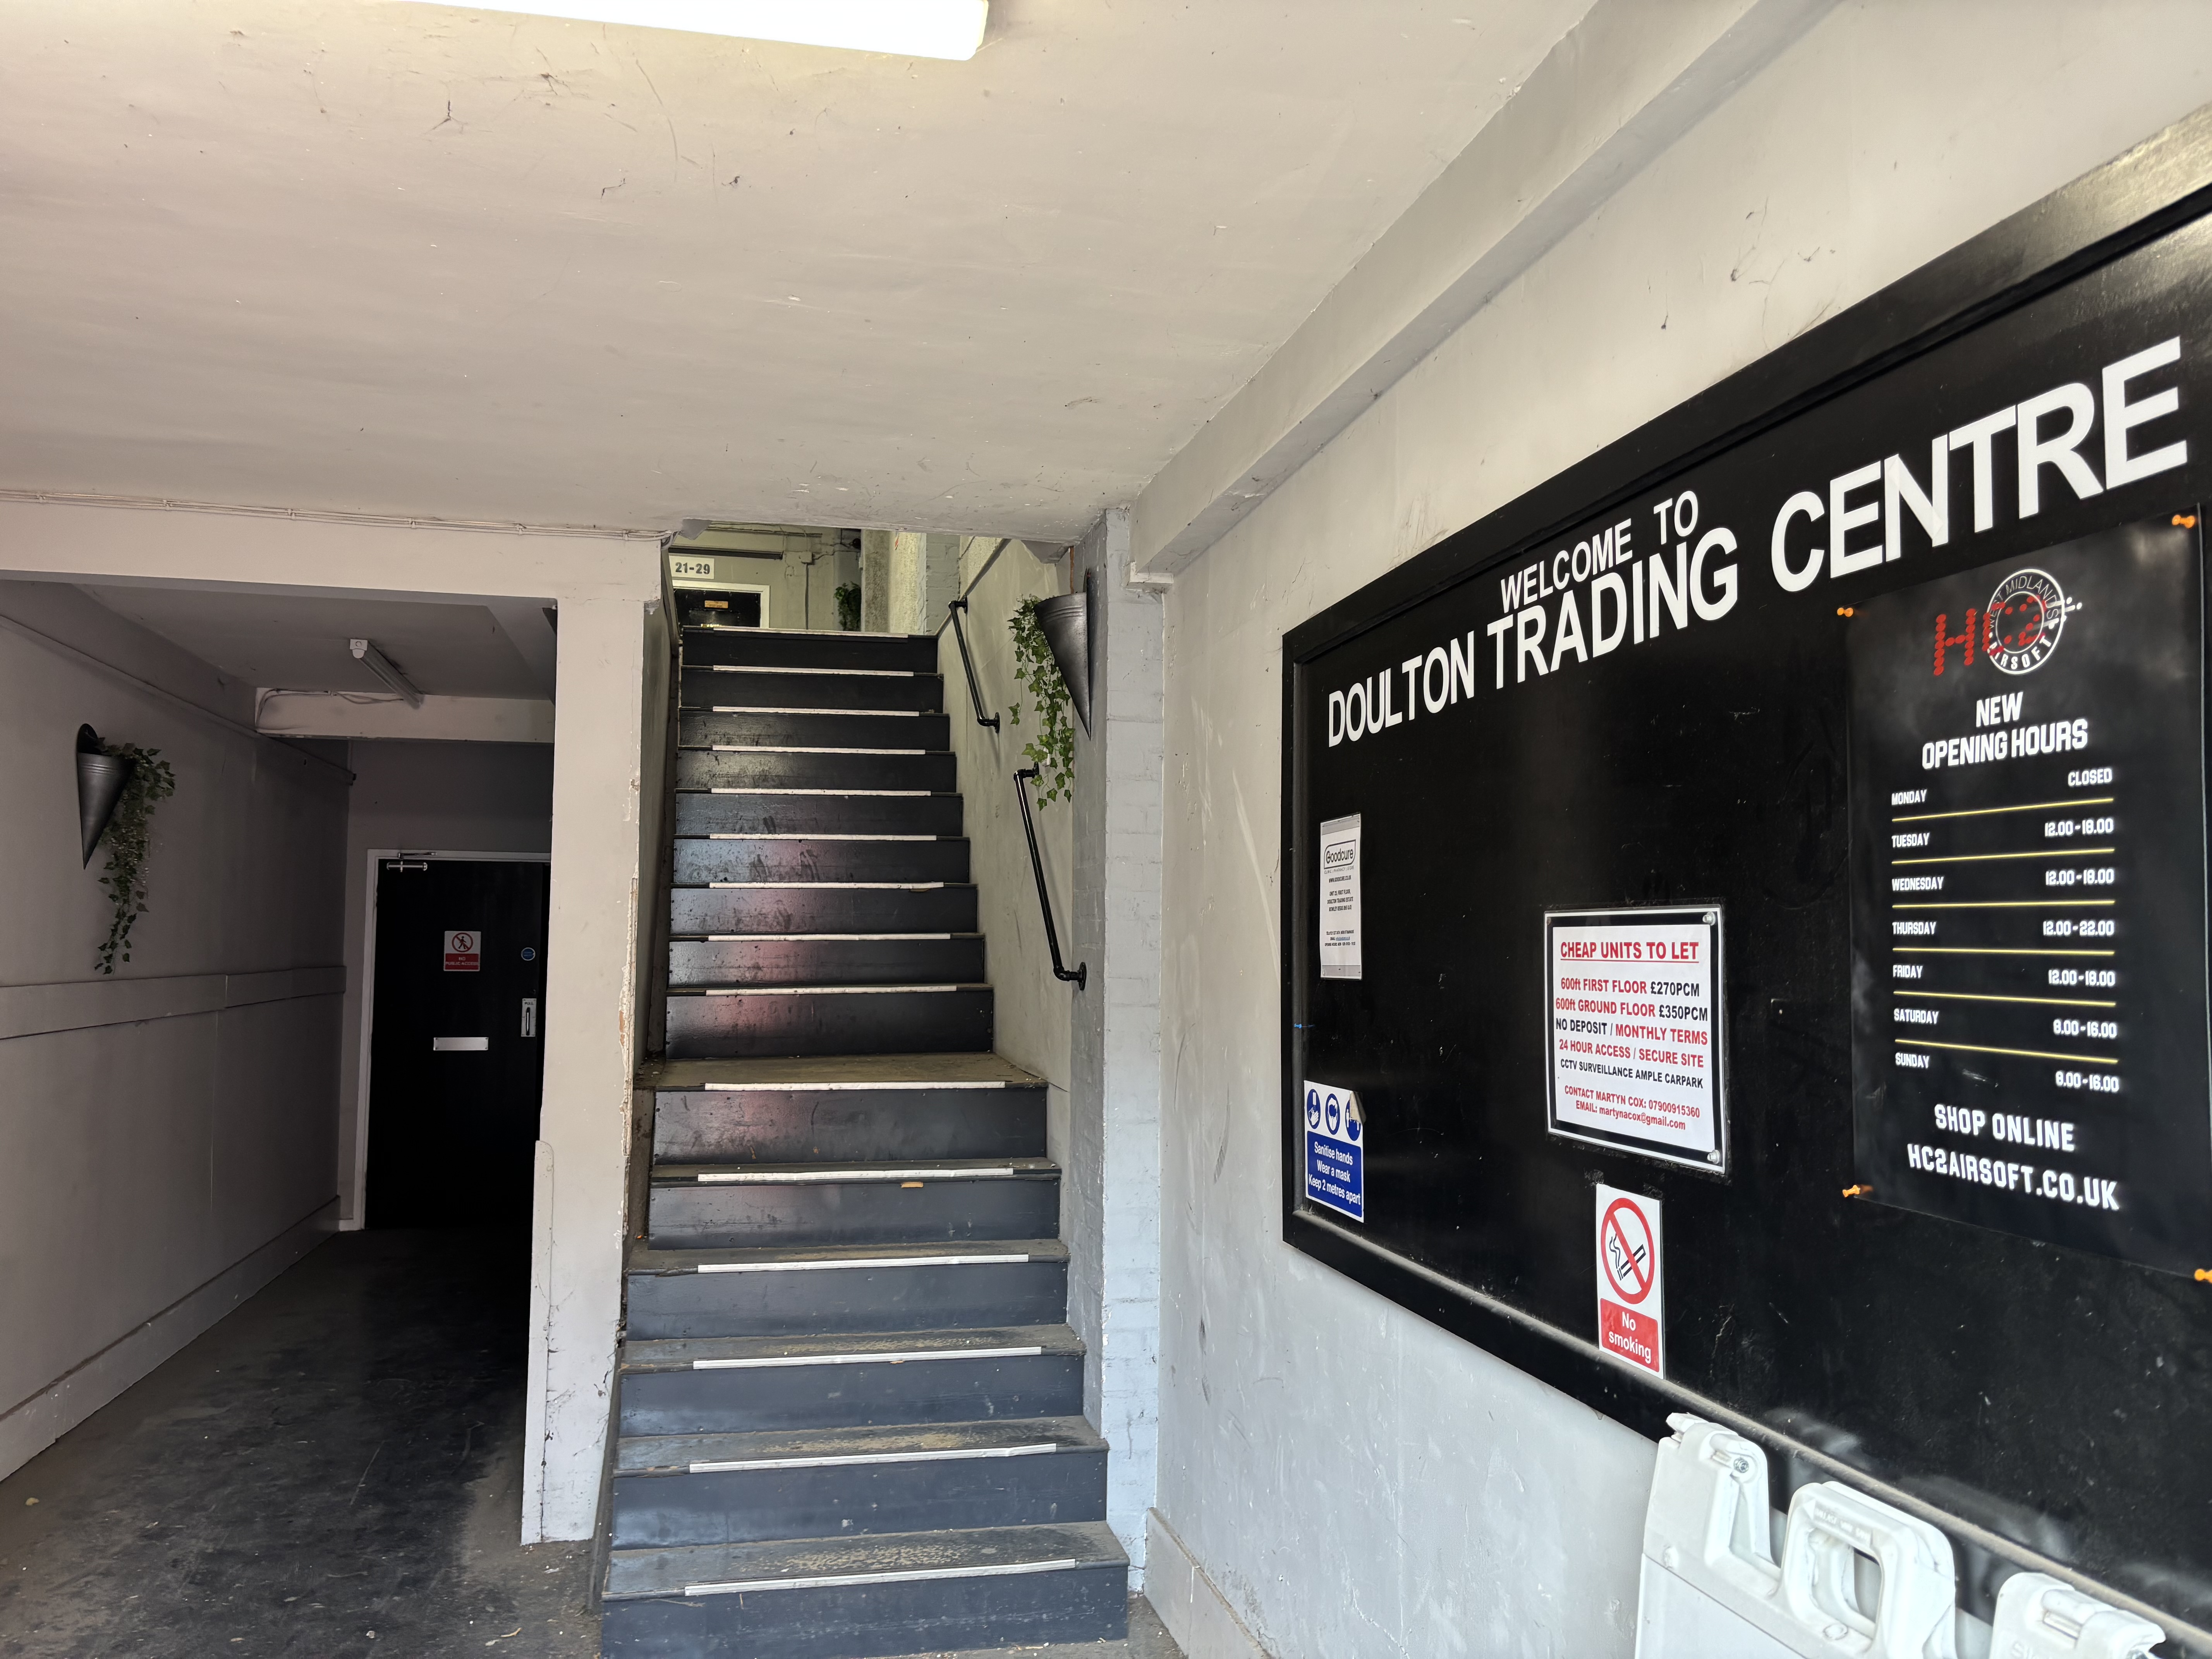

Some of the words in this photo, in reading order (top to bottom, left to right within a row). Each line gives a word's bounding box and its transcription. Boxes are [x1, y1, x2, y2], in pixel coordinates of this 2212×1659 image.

[1328, 631, 1475, 747] DOULTON
[1487, 526, 1738, 690] TRADING
[1771, 337, 2188, 593] CENTRE
[1500, 518, 1632, 613] WELCOME
[1653, 490, 1698, 543] TO
[675, 562, 711, 575] 21-29
[2006, 576, 2059, 620] MIDLANDS
[1976, 691, 2023, 727] NEW
[1922, 732, 2008, 769] OPENING
[2011, 719, 2088, 757] HOURS
[1892, 789, 1927, 805] MONDAY
[2068, 768, 2112, 787] CLOSED
[1892, 833, 1930, 848] TUESDAY
[1326, 848, 1353, 864] Goodcure
[1892, 876, 1944, 891] WEDNESDAY
[1892, 921, 1936, 936] THURSDAY
[1561, 941, 1597, 958] CHEAP
[1601, 941, 1642, 959] UNITS
[1646, 941, 1666, 960] TO
[1671, 941, 1699, 960] LET
[1893, 965, 1923, 979] FRIDAY
[1561, 977, 1581, 991] 600ft
[1583, 978, 1609, 992] FIRST
[1612, 979, 1647, 994] FLOOR
[1650, 981, 1699, 997] £270PCM
[1556, 997, 1576, 1012] 600ft
[1578, 999, 1617, 1015] GROUND
[1620, 1002, 1656, 1017] FLOOR
[1659, 1004, 1708, 1022] £350PCM
[1894, 1008, 1939, 1024] SATURDAY
[1556, 1018, 1567, 1030] NO
[1570, 1019, 1607, 1036] DEPOSIT
[1610, 1023, 1613, 1036] /
[1615, 1024, 1667, 1041] MONTHLY
[1670, 1029, 1708, 1046] TERMS
[1559, 1039, 1568, 1051] 24
[1570, 1040, 1593, 1055] HOUR
[1595, 1043, 1631, 1059] ACCESS
[1633, 1048, 1636, 1060] /
[1639, 1048, 1678, 1065] SECURE
[1681, 1053, 1704, 1068] SITE
[1895, 1052, 1930, 1068] SUNDAY
[1561, 1058, 1577, 1070] CCTV
[1579, 1062, 1633, 1078] SURVEILLANCE
[1635, 1069, 1662, 1082] AMPLE
[1665, 1073, 1703, 1089] CARPARK
[1565, 1085, 1594, 1099] CONTACT
[1596, 1091, 1626, 1105] MARTYN
[1628, 1096, 1646, 1109] COX:
[1649, 1099, 1700, 1118] 07900915360
[1576, 1100, 1597, 1113] EMAIL:
[1599, 1105, 1686, 1130] martynacox@gmail.com
[1934, 1103, 1985, 1136] SHOP
[1992, 1113, 2075, 1152] ONLINE
[1314, 1141, 1335, 1159] Sanitise
[1336, 1149, 1353, 1166] hands
[1317, 1159, 1330, 1175] Wear
[1331, 1168, 1334, 1176] a
[1335, 1169, 1350, 1183] mask
[1907, 1142, 2119, 1211] HC2AIRSOFT.CO.UK
[1309, 1173, 1321, 1191] Keep
[1322, 1179, 1326, 1190] 2
[1326, 1183, 1345, 1199] metres
[1346, 1190, 1360, 1205] apart
[1622, 1311, 1636, 1331] No
[1609, 1331, 1651, 1364] smoking
